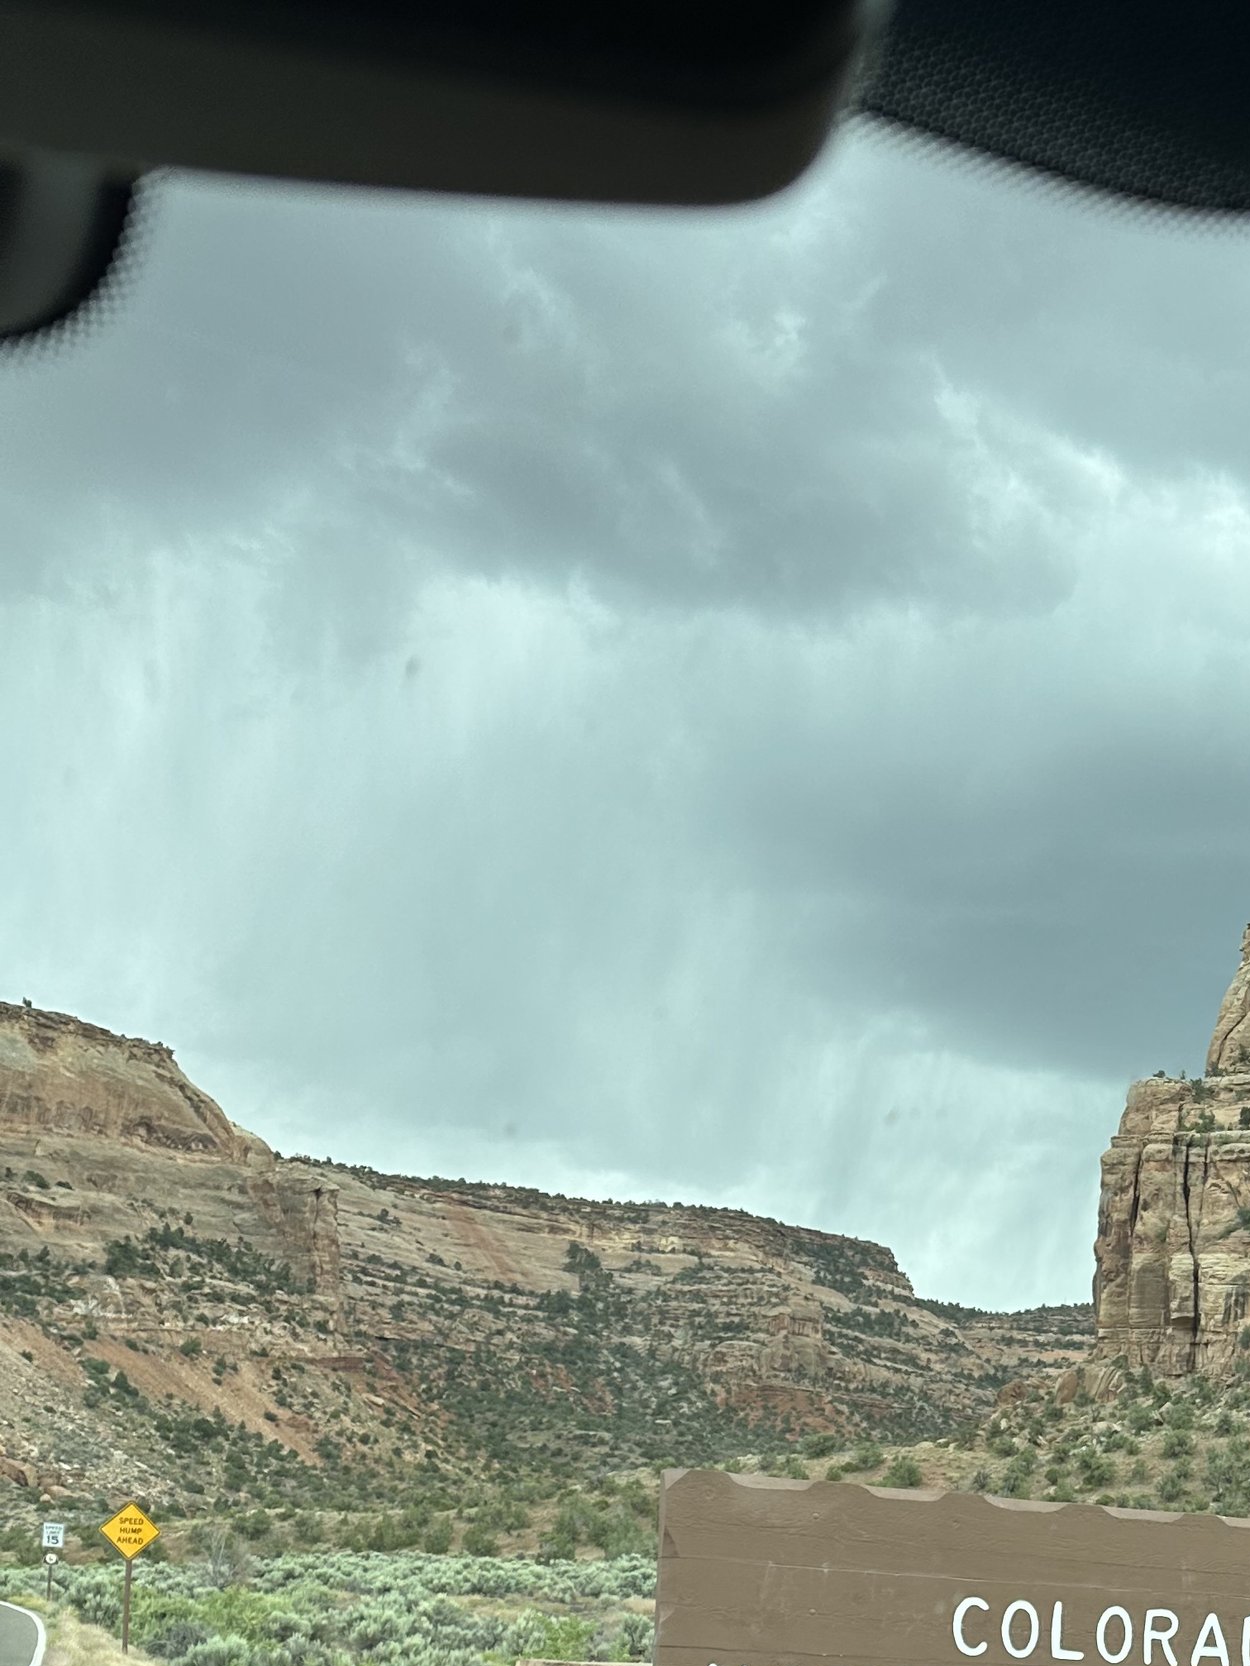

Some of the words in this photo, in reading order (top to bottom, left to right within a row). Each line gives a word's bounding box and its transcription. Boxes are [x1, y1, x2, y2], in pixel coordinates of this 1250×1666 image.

[119, 1517, 144, 1526] SPEED
[119, 1527, 142, 1535] HUMP
[47, 1535, 59, 1545] 15
[116, 1536, 144, 1546] AHEAD
